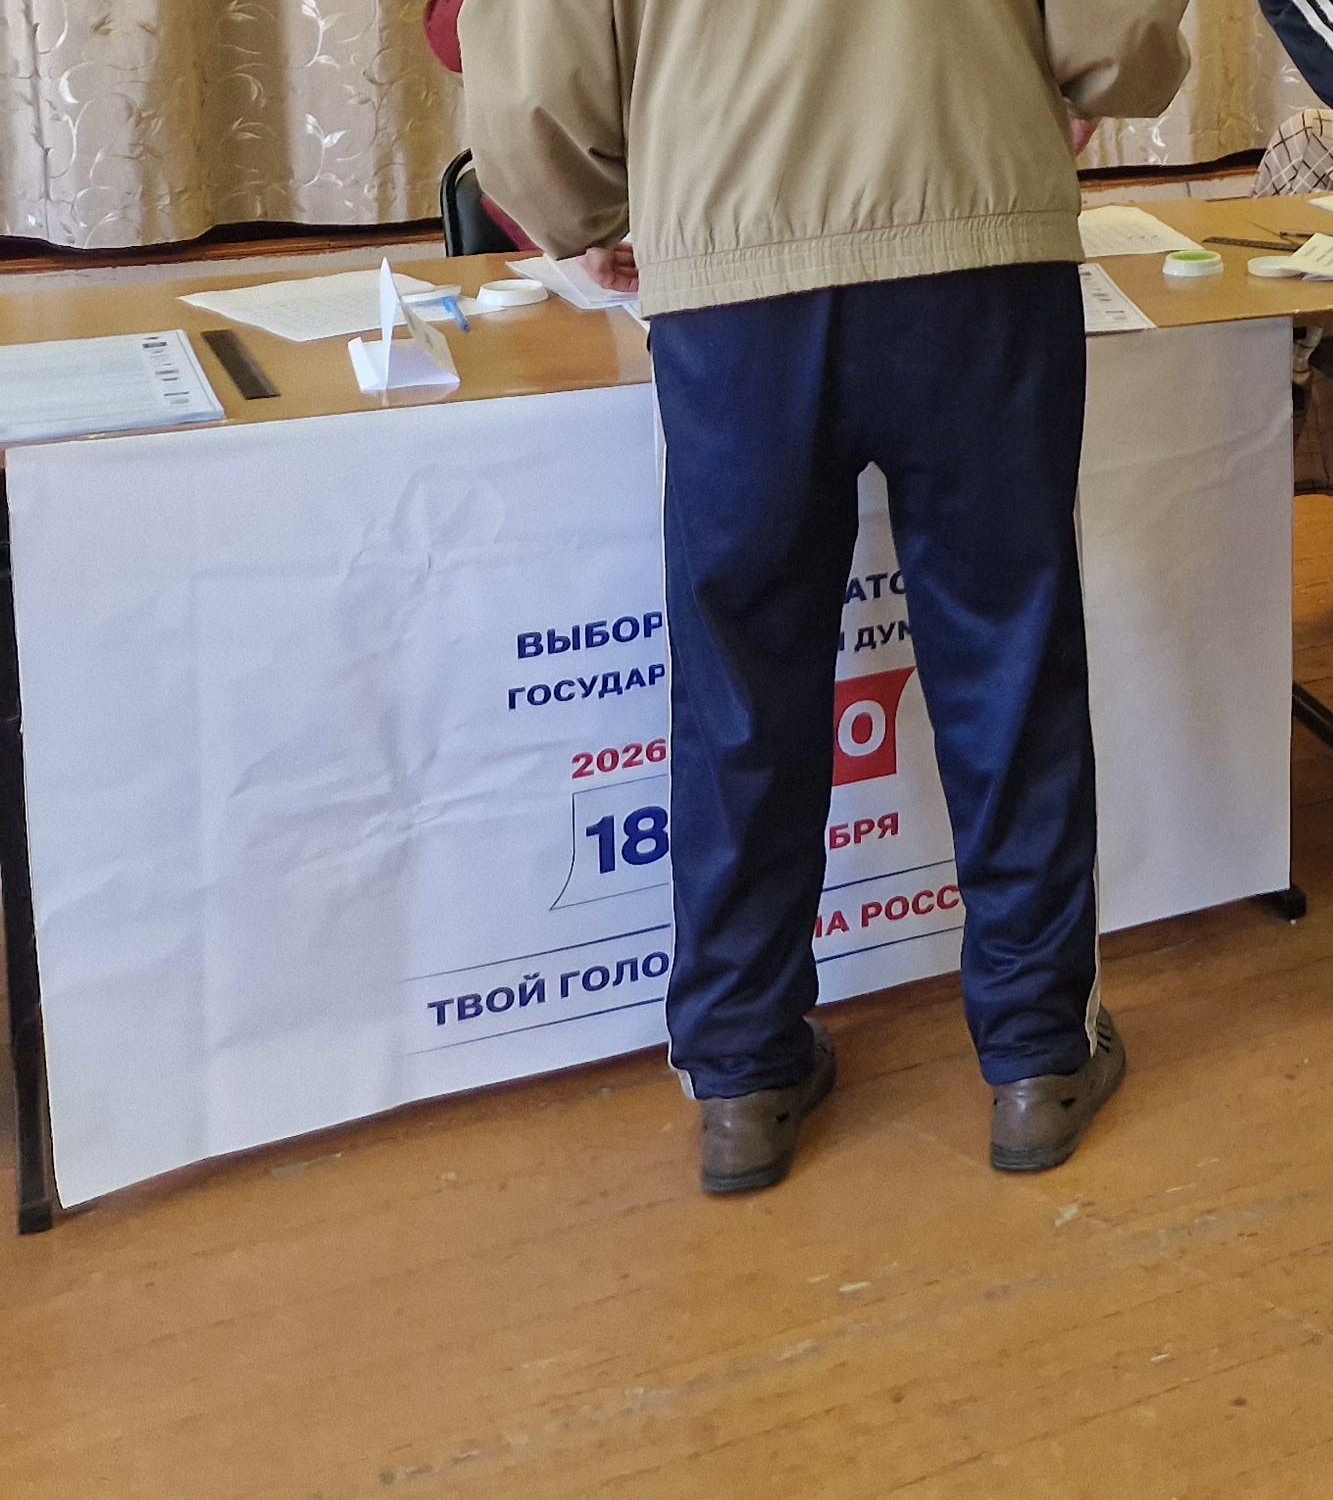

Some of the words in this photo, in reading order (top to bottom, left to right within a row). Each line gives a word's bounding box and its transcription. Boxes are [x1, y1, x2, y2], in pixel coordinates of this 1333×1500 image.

[516, 611, 664, 660] ВЫБОР
[571, 737, 667, 780] 2026
[586, 805, 670, 875] 18
[860, 883, 961, 929] РОСС
[427, 971, 547, 1027] ТВОЙ
[560, 951, 670, 1000] ГОЛО
